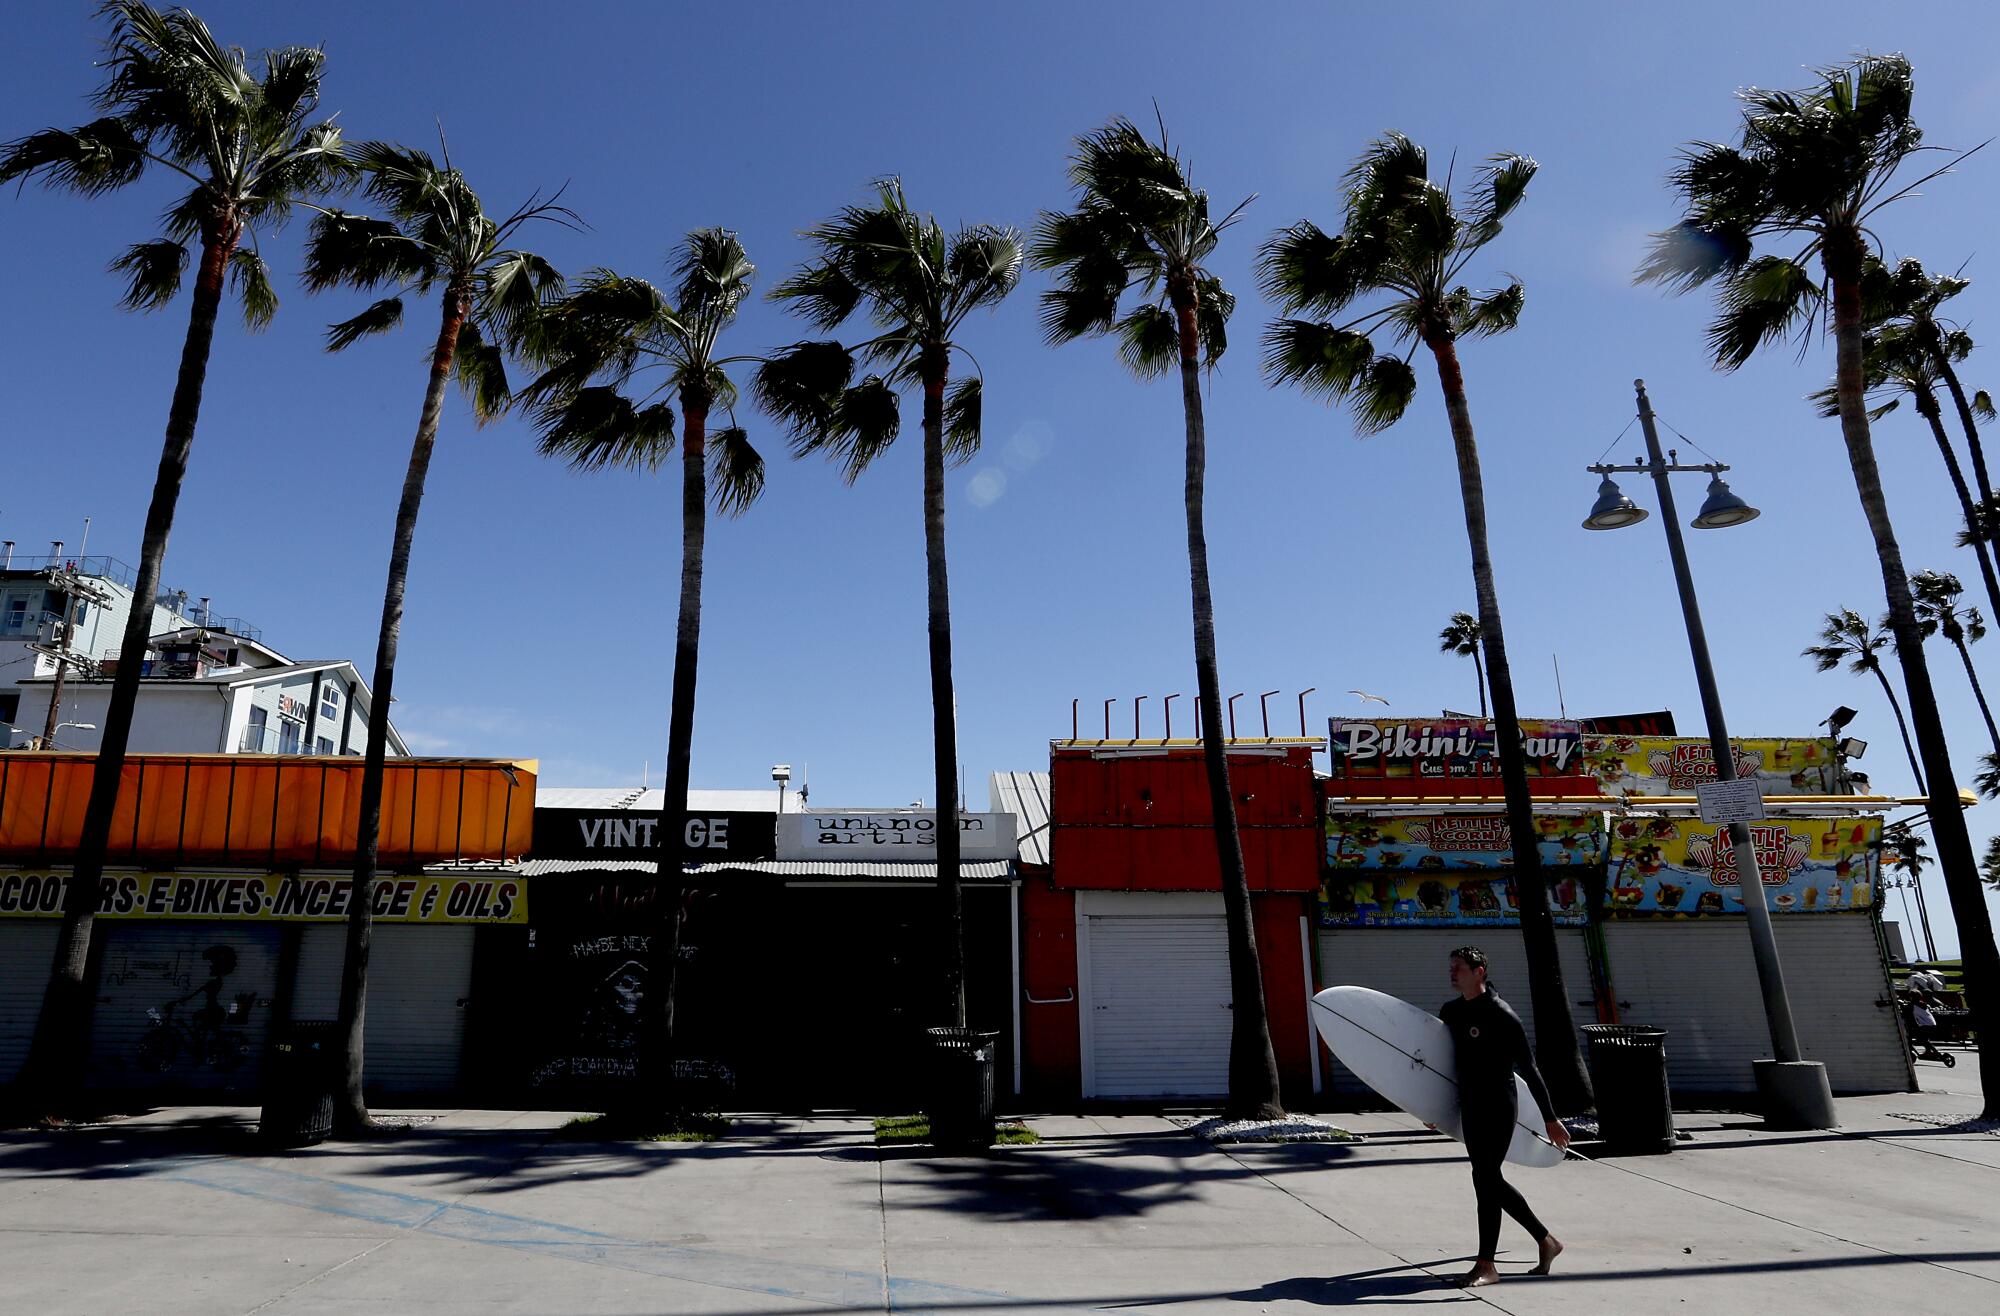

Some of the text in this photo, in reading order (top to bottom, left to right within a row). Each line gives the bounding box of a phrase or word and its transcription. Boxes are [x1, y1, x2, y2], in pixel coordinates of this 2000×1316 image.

[1340, 722, 1476, 760] Bikini
[1485, 722, 1577, 771] ay
[1676, 745, 1739, 765] KETE
[1419, 760, 1466, 775] Cusom
[1681, 763, 1718, 776] COR
[813, 817, 984, 831] unknon
[1432, 817, 1503, 833] KETTLE
[578, 818, 729, 850] VINTGE
[817, 829, 937, 847] artis
[1440, 831, 1496, 841] CORN
[1718, 828, 1787, 852] KTLE
[1434, 842, 1504, 851] CORNER
[1724, 851, 1778, 867] CRN
[1716, 870, 1783, 883] COER
[272, 879, 417, 916] INCECE
[446, 882, 517, 917] OILS
[623, 935, 651, 953] NEX
